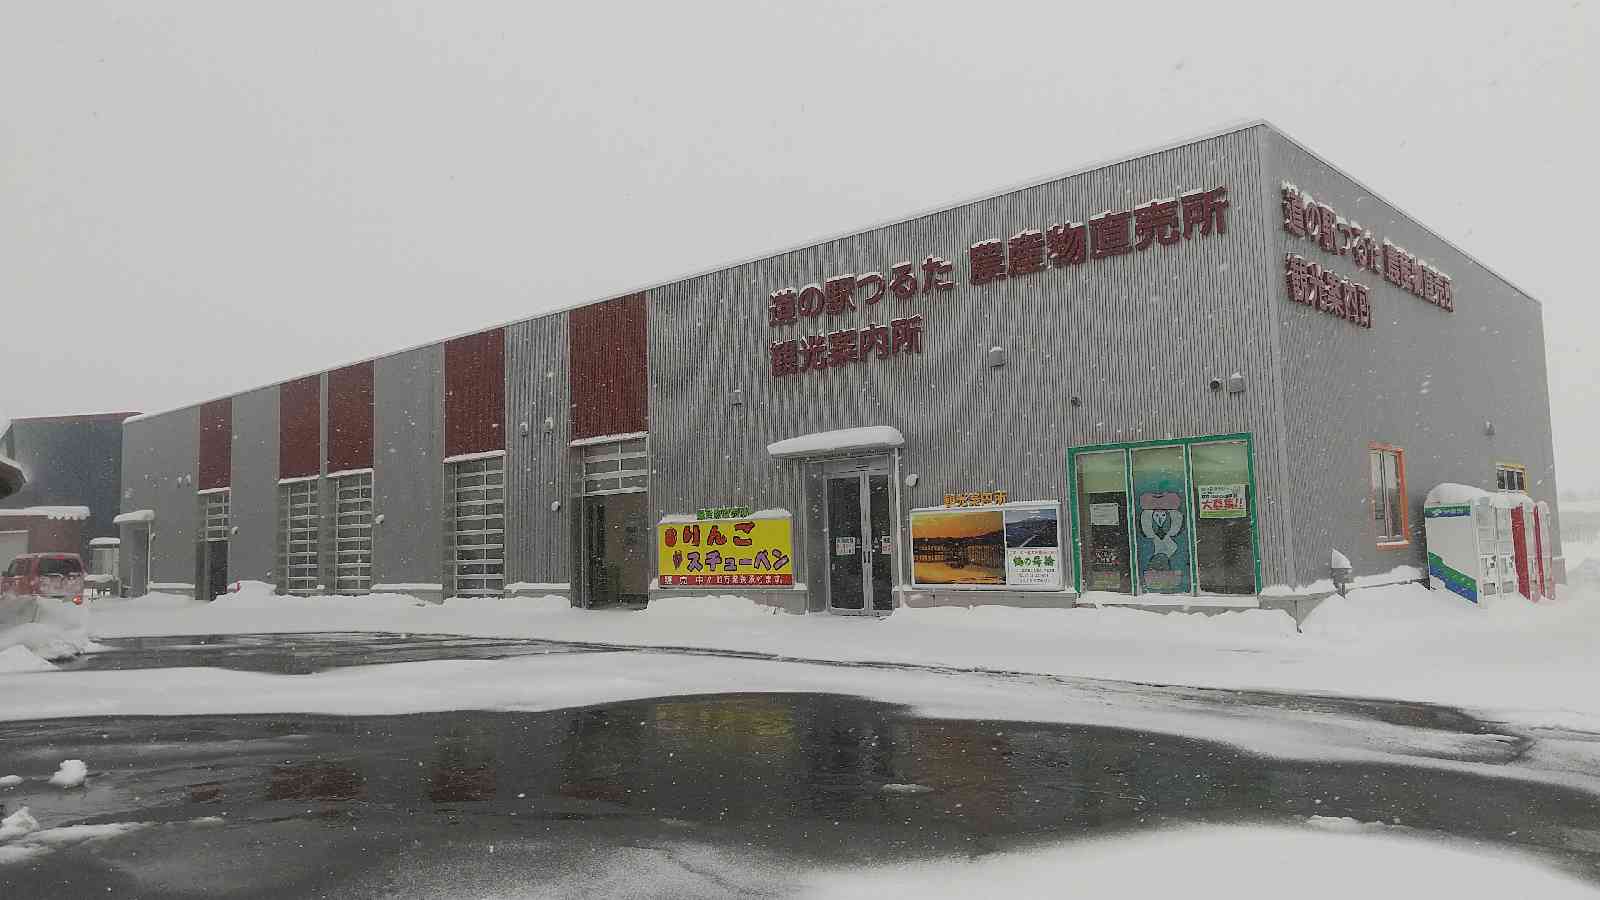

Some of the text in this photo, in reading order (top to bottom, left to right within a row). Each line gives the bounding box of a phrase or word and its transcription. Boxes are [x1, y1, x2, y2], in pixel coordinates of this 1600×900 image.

[769, 186, 1229, 327] 道の駅つるた 農産物直売所
[770, 314, 922, 377] 観光案内所
[682, 521, 756, 547] りんご
[686, 549, 790, 572] スチューベン
